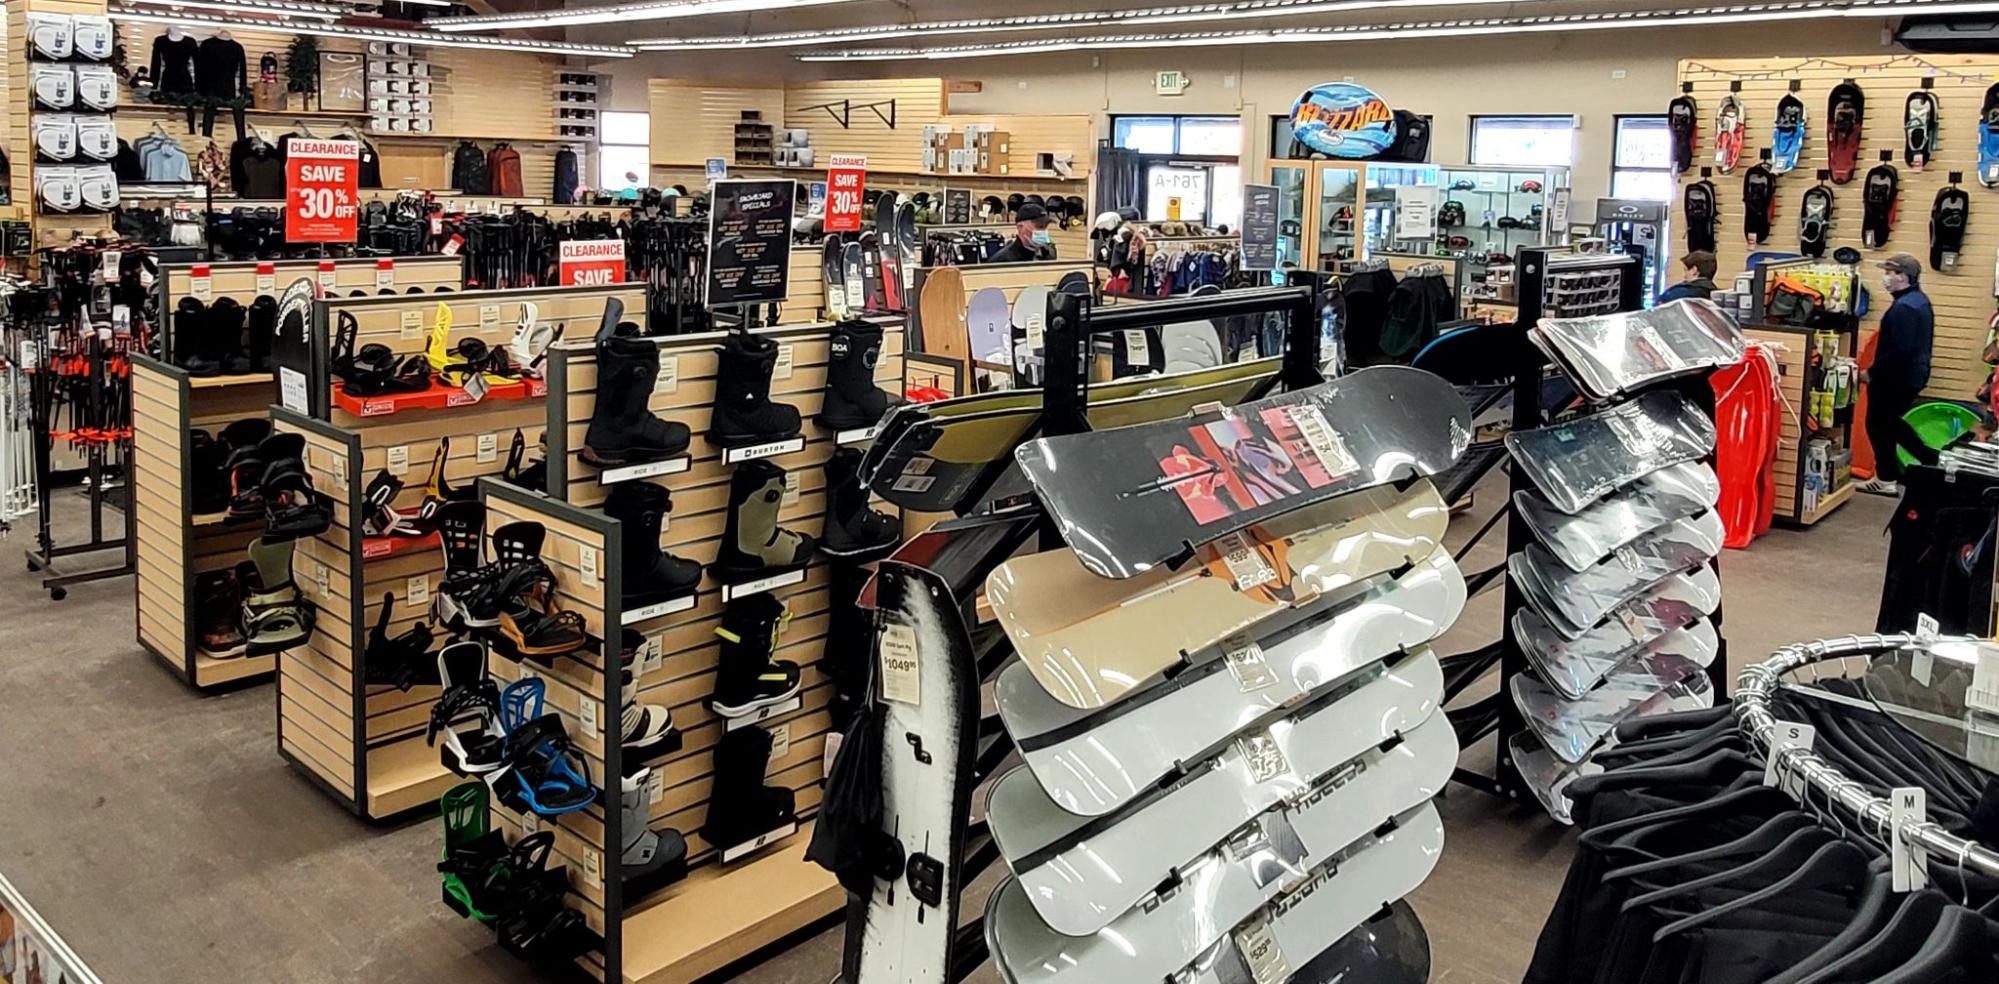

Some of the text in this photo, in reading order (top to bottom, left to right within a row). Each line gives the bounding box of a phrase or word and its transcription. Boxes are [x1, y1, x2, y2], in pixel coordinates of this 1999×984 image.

[1160, 73, 1177, 88] EXIT
[290, 142, 357, 155] CLEARANCE
[832, 157, 865, 167] CLEARANCE
[300, 165, 346, 183] SAVE
[834, 174, 859, 187] SAVE
[334, 205, 356, 219] OFF
[849, 203, 862, 214] OFF
[562, 243, 623, 258] CLEARANCE
[573, 268, 614, 286] SAVE
[831, 343, 849, 352] BOA
[752, 444, 785, 456] BURTON
[1919, 617, 1936, 634] 3XL
[1788, 727, 1800, 739] S
[1903, 795, 1916, 809] M
